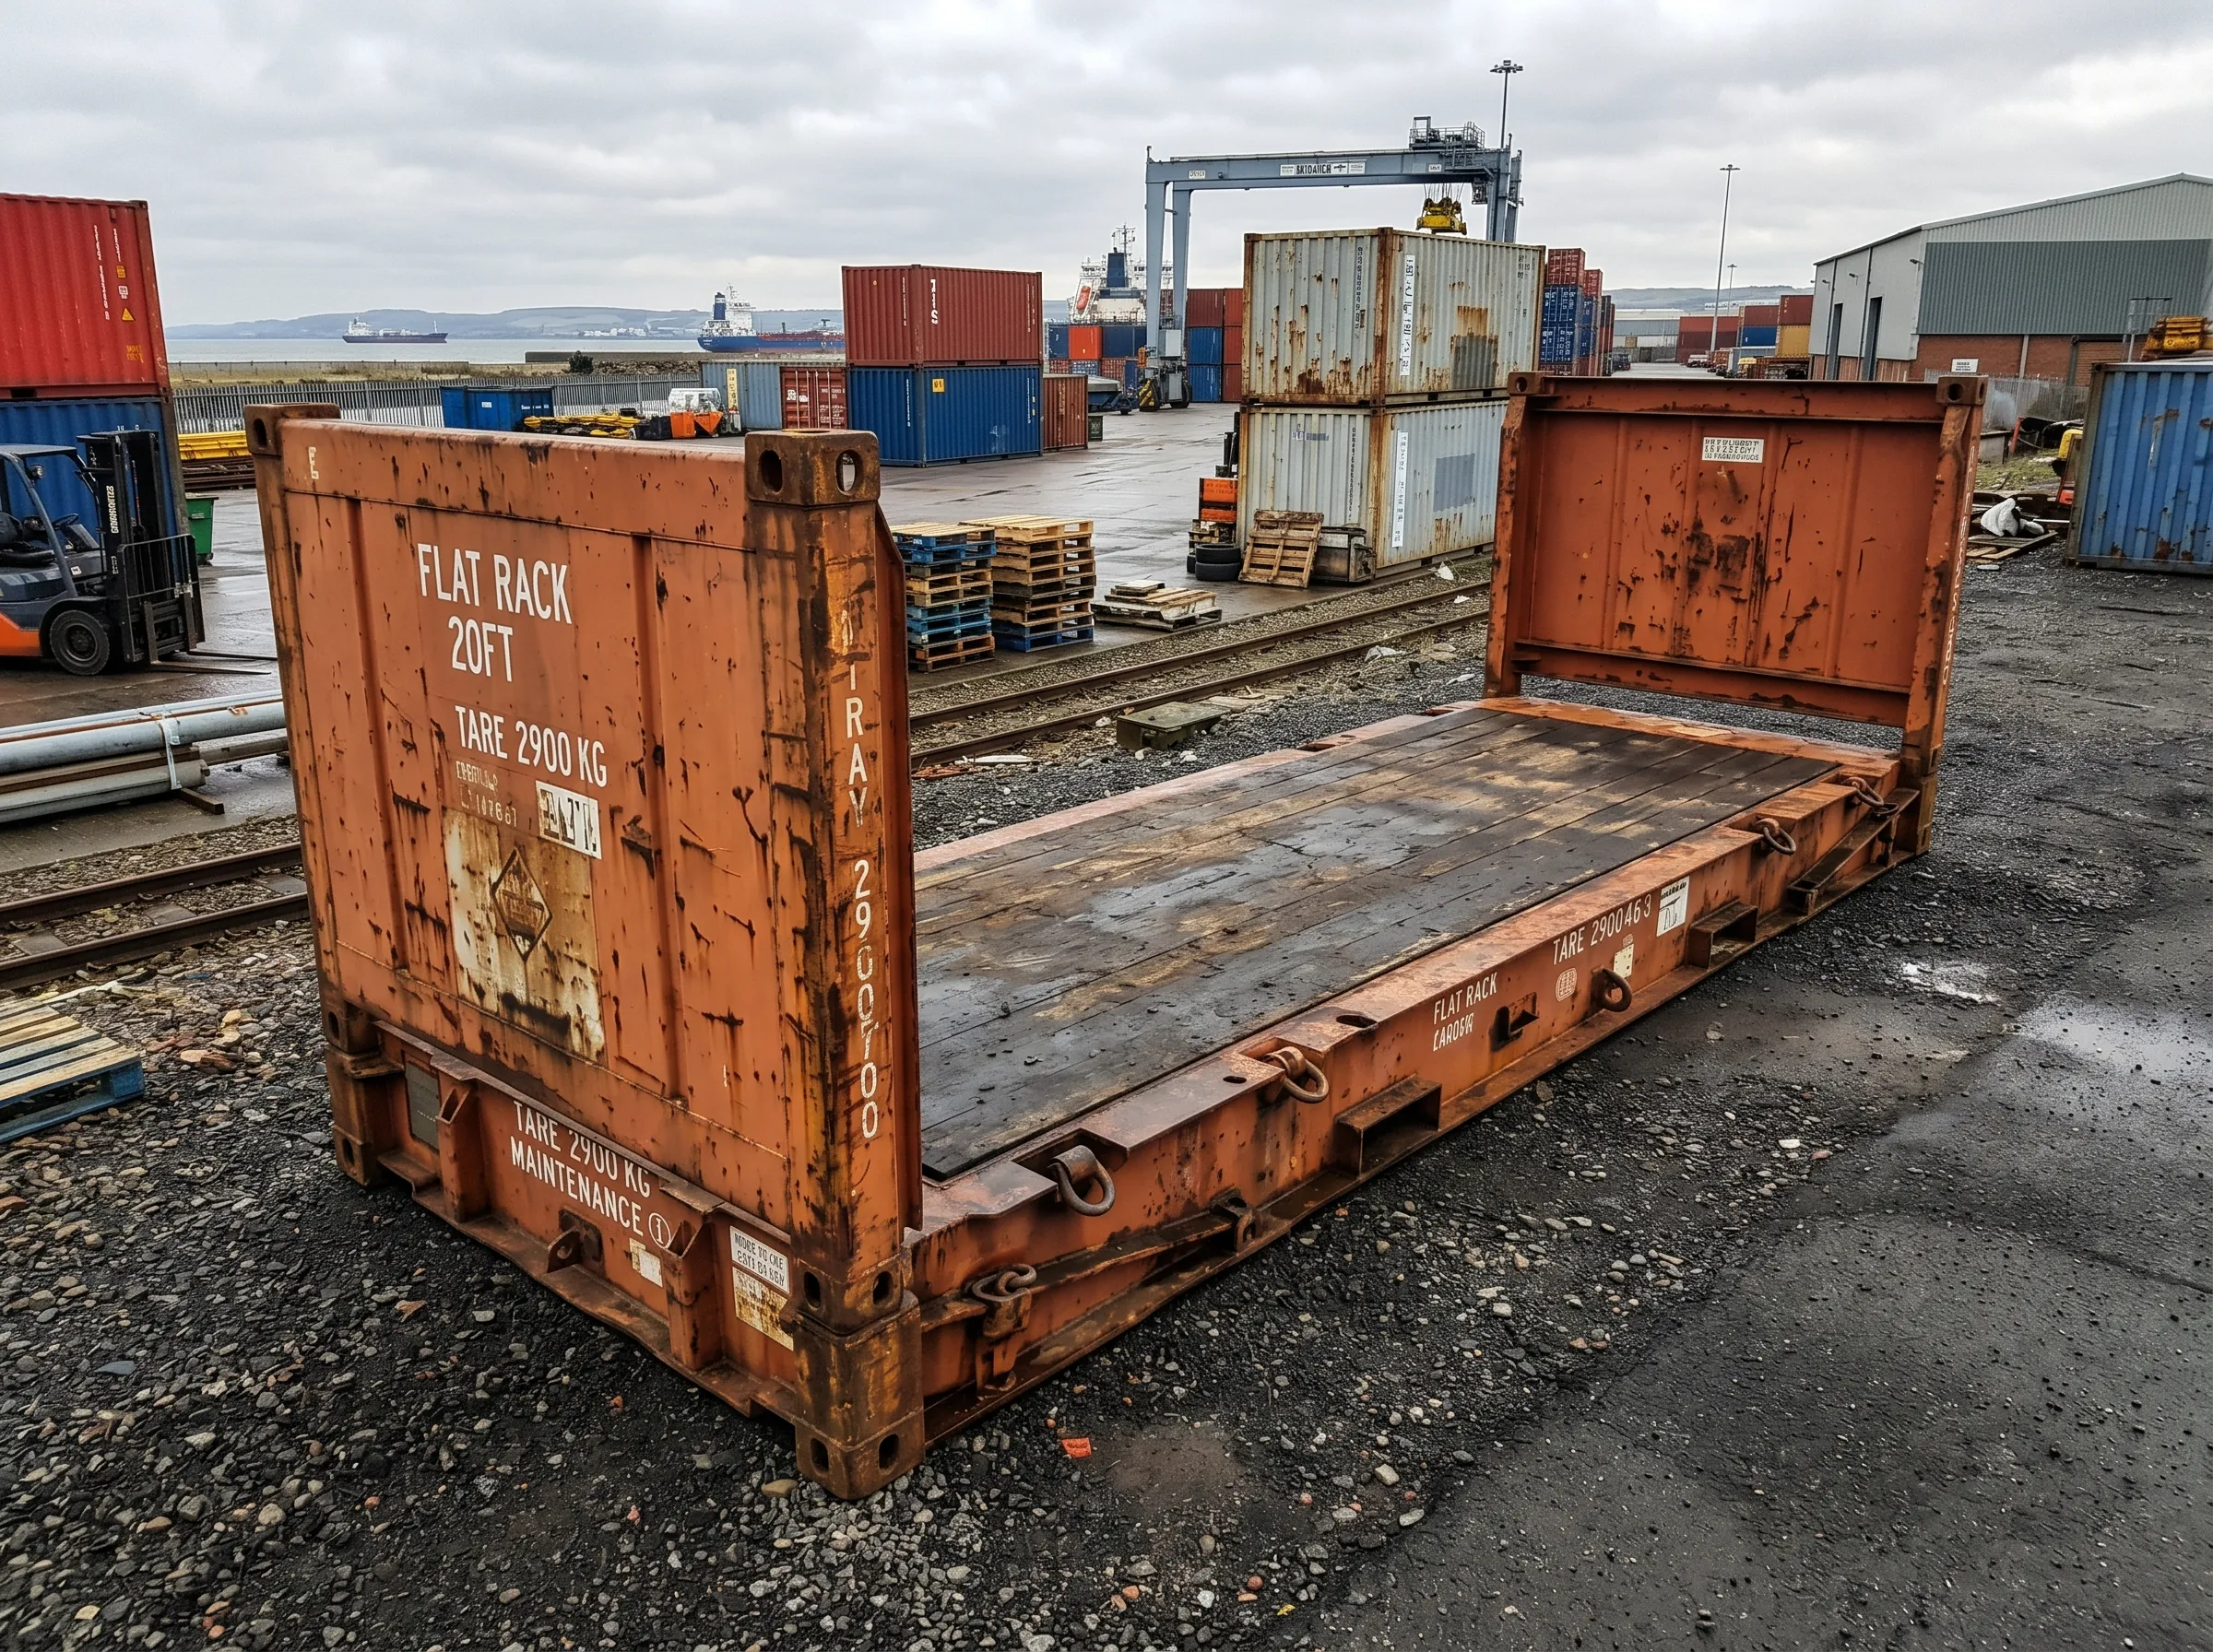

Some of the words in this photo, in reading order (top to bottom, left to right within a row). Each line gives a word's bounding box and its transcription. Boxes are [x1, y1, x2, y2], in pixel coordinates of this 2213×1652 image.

[418, 543, 480, 607] FLAT
[493, 554, 572, 625] RACK
[448, 616, 514, 682] 20FT
[455, 705, 508, 759] TARE
[515, 721, 572, 777] 2900
[577, 737, 608, 787] KG
[1553, 926, 1586, 965] TARE
[1434, 989, 1462, 1025] FLAT
[1466, 972, 1497, 1008] RACK
[510, 1135, 644, 1236] MAINTENANCE
[514, 1100, 562, 1152] TARE
[568, 1129, 618, 1181] 2900
[624, 1160, 650, 1198] KG
